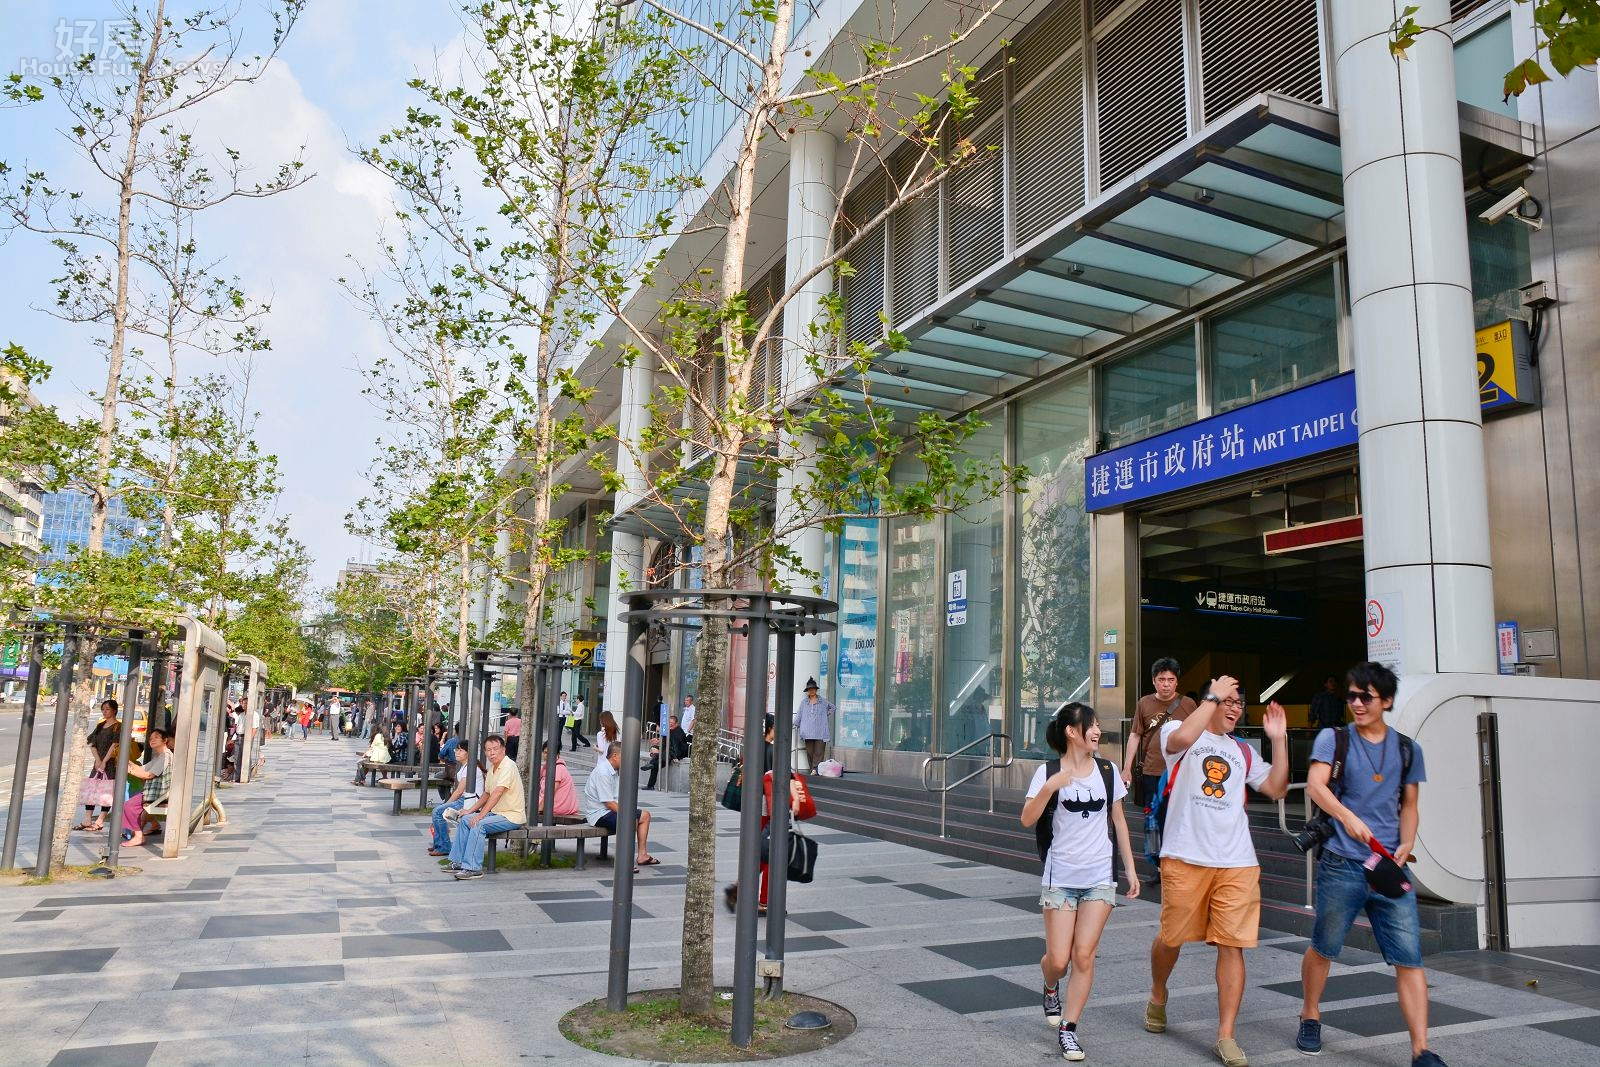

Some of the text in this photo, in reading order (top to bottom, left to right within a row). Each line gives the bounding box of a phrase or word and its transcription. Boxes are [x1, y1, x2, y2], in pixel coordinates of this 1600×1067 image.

[1090, 423, 1245, 498] 捷運市政府站
[1253, 429, 1287, 455] MRT
[1291, 412, 1345, 443] TAIPEI
[1218, 592, 1266, 606] 捷運市政府站
[1230, 604, 1243, 612] Taipei
[1243, 605, 1253, 613] City
[579, 648, 592, 667] 2
